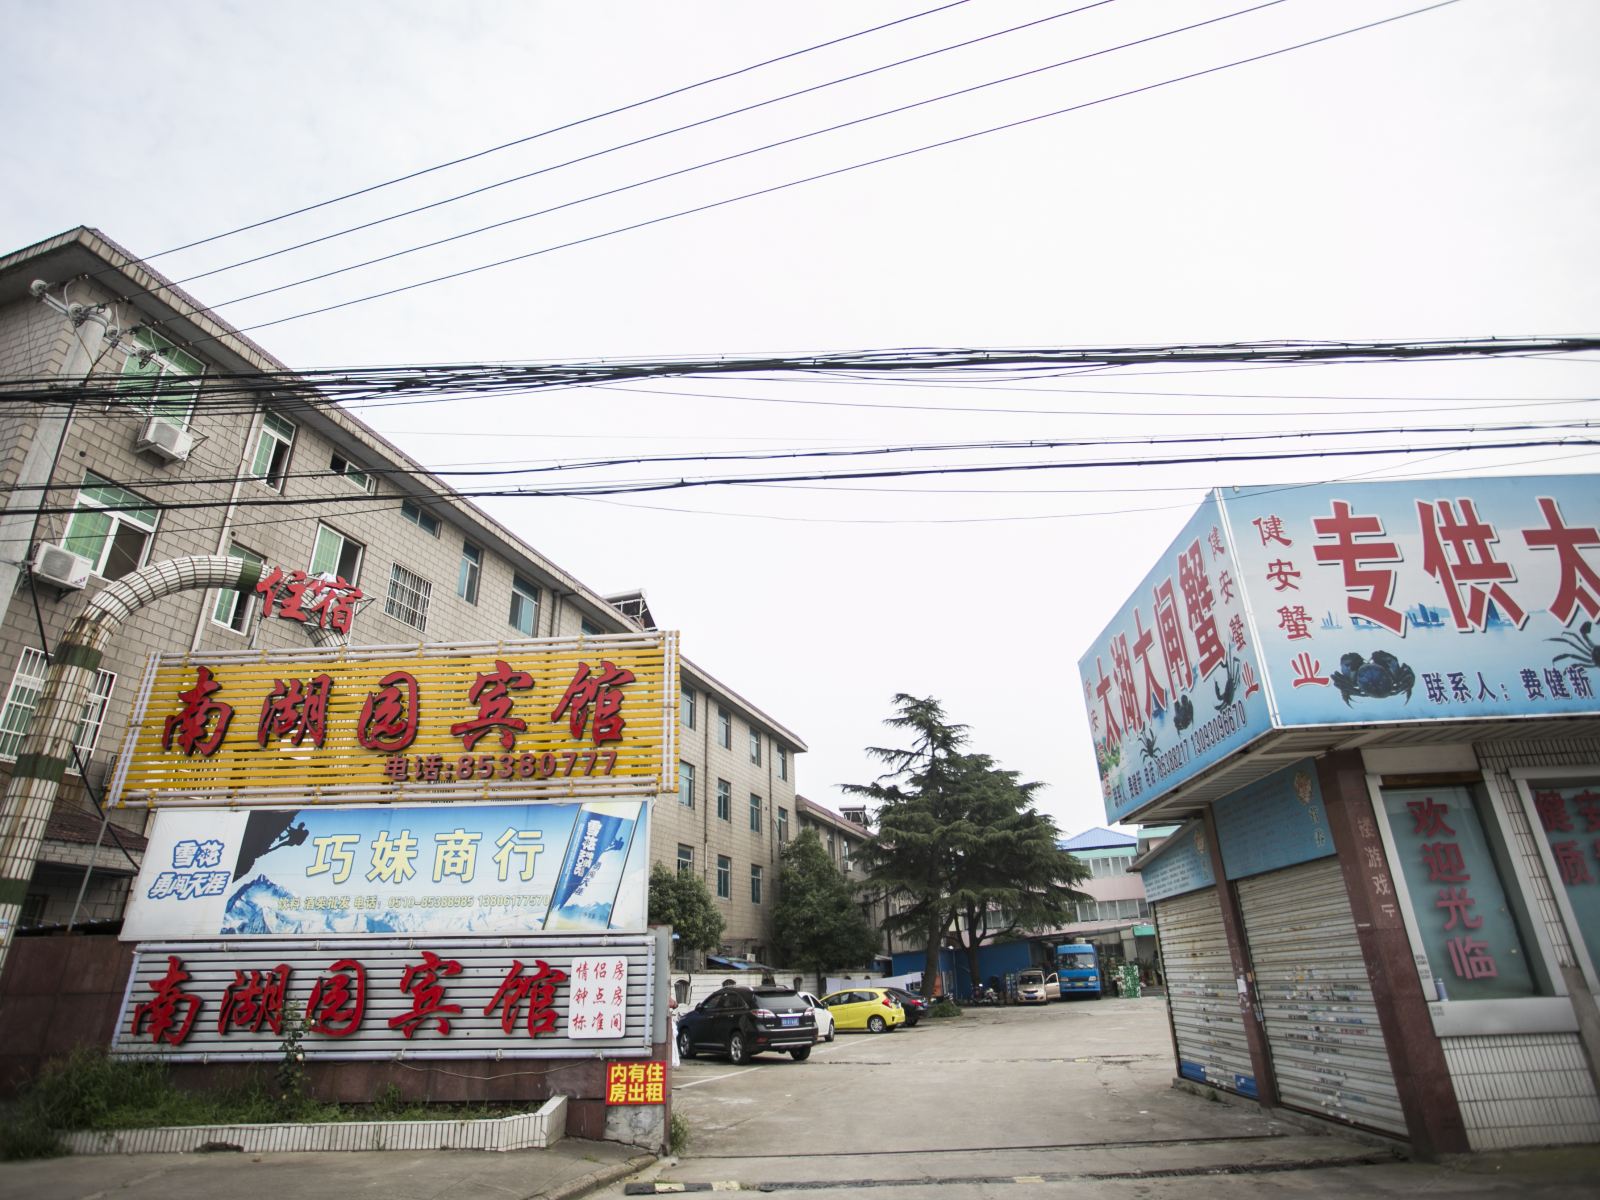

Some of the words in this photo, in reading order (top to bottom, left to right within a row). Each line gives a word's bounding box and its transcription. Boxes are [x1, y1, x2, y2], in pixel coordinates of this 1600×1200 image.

[1312, 496, 1600, 638] 专供太
[256, 566, 363, 635] 住宿
[1208, 524, 1260, 701] 健安蟹业
[1252, 515, 1330, 688] 健安蟹业
[1094, 536, 1226, 754] 太湖大闸蟹
[306, 826, 545, 885] 巧妹商行
[1407, 797, 1498, 980] 欢迎光临
[573, 986, 624, 1007] 钟点房
[575, 960, 625, 982] 情侣房
[572, 1012, 622, 1033] 标准间
[609, 1083, 664, 1103] 房出租
[610, 1063, 664, 1083] 内有住
